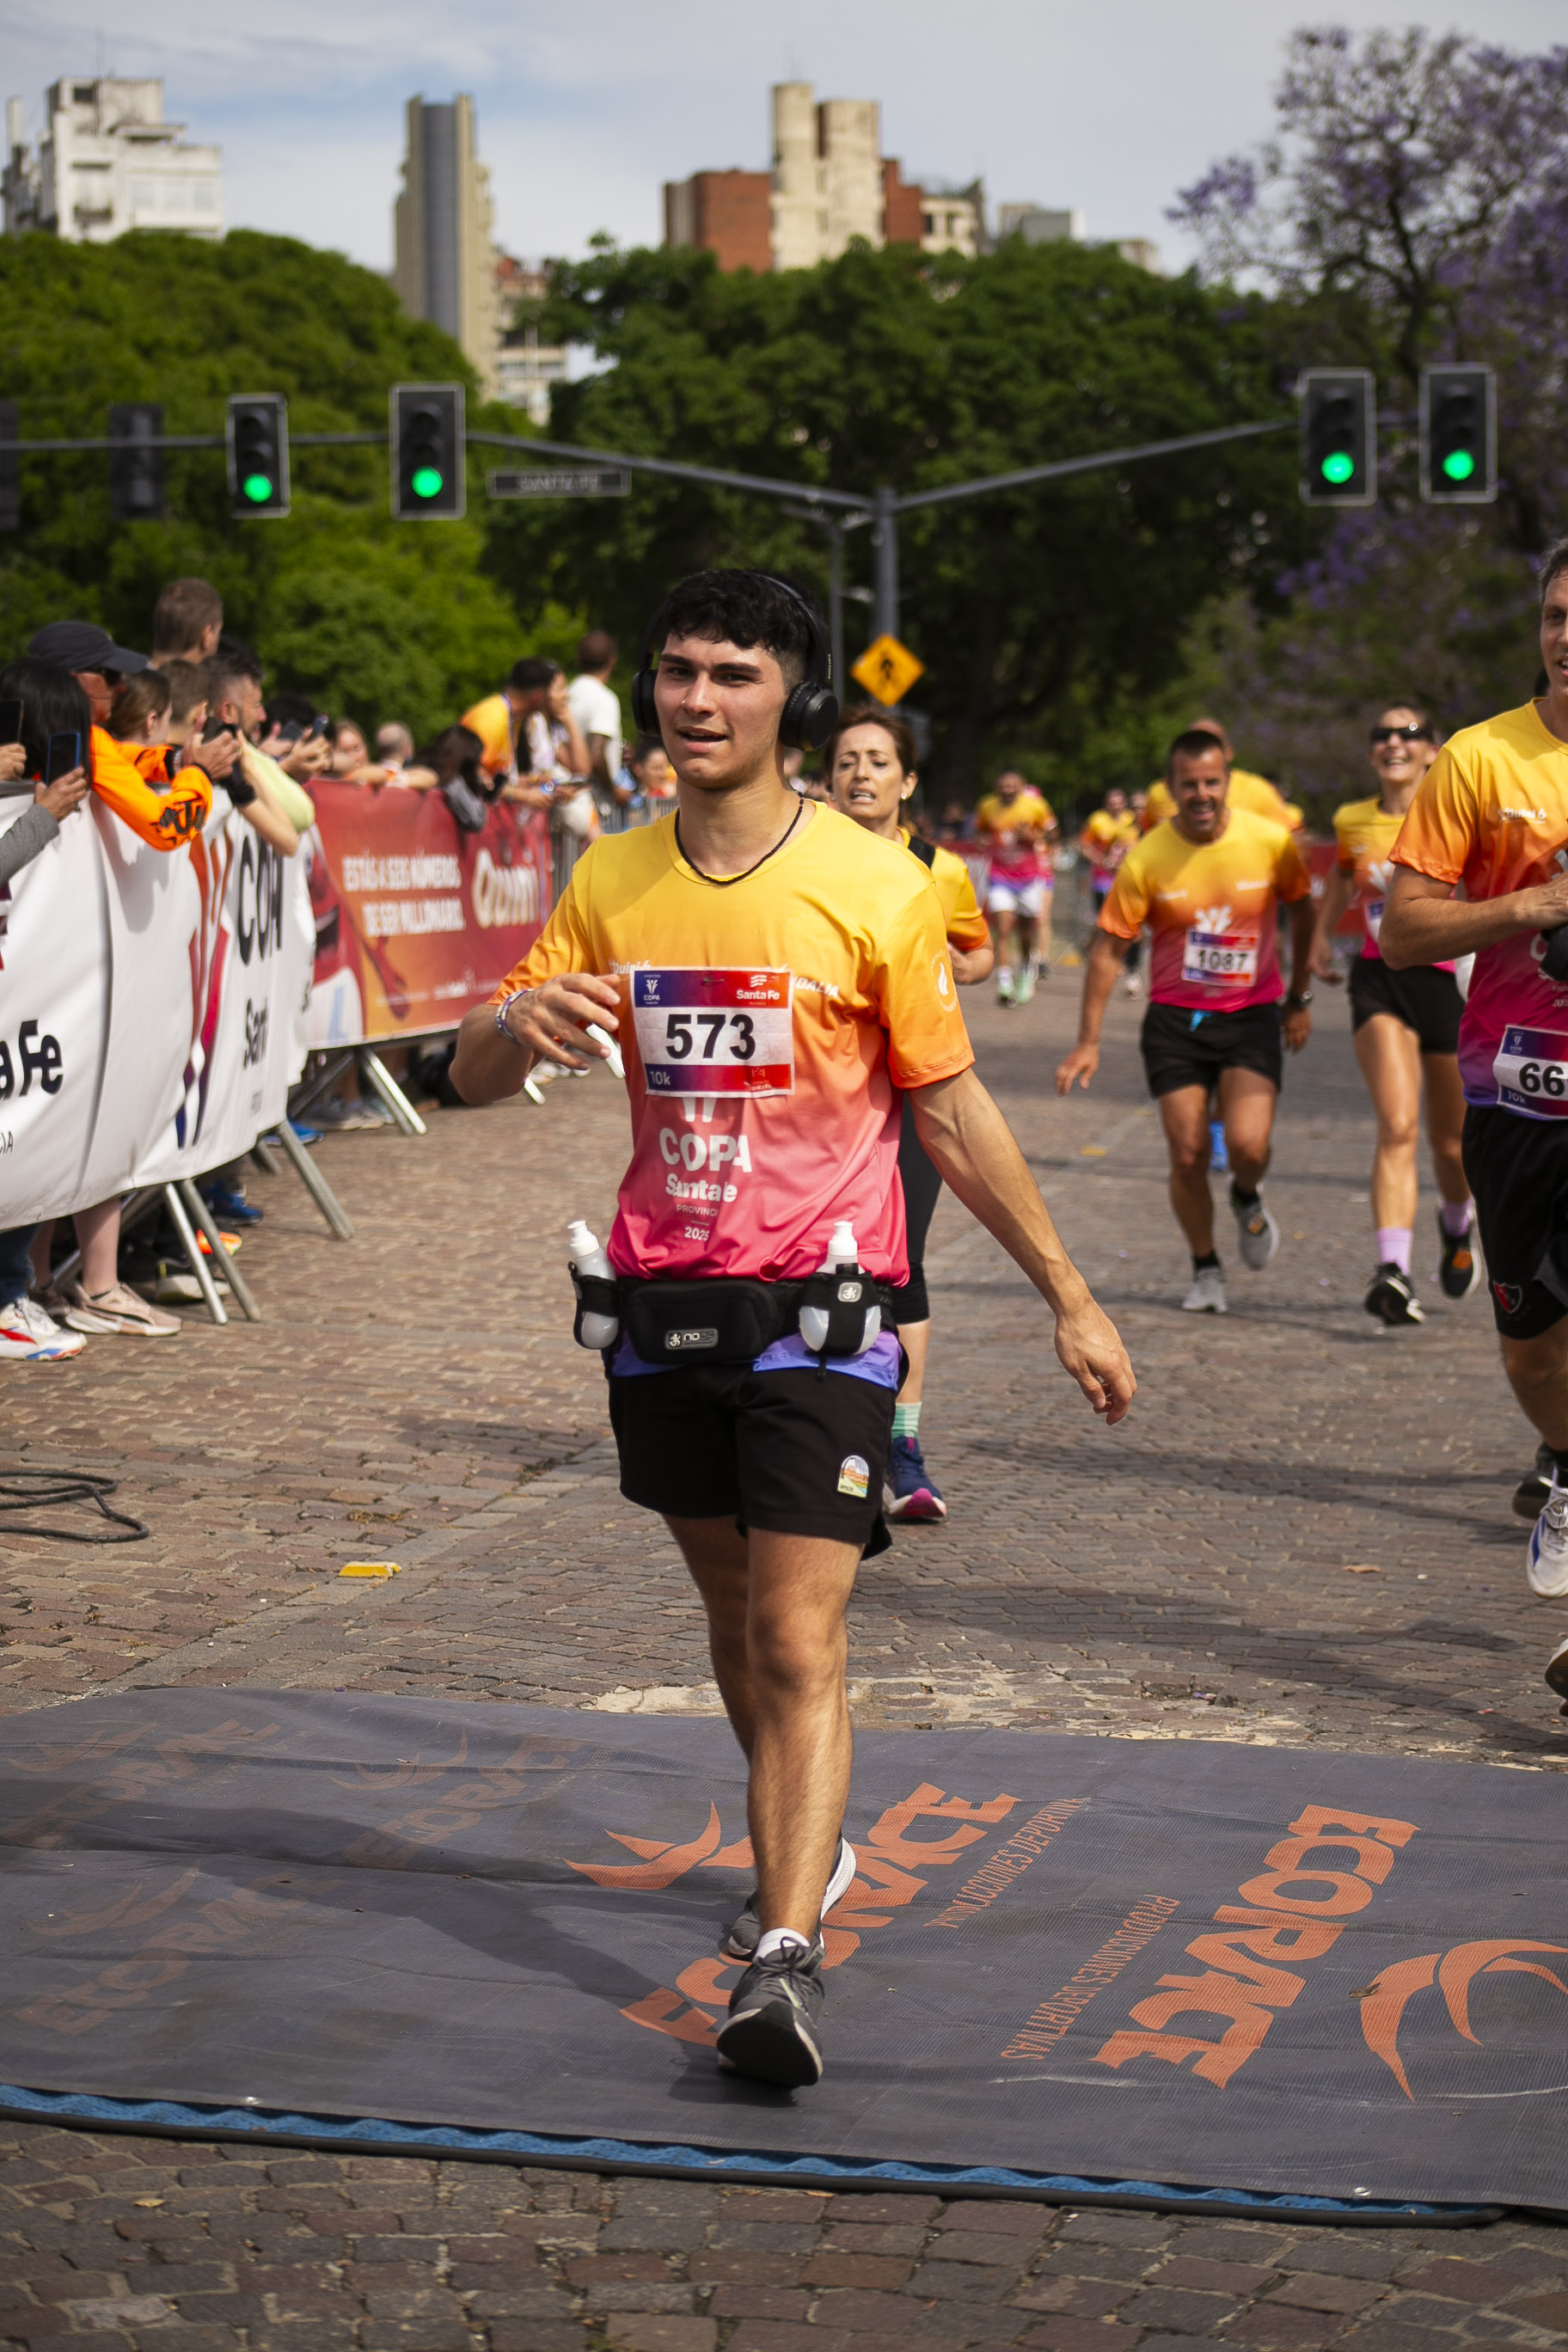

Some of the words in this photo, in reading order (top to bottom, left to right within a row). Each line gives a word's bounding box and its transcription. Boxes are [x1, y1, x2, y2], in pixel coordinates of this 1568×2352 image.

[1538, 808, 1547, 819] 6
[736, 989, 767, 1000] Santa
[767, 989, 780, 1000] Fe
[666, 1014, 756, 1060] 573
[651, 1071, 671, 1086] 10k
[1519, 1063, 1568, 1096] 66
[659, 1128, 753, 1173] COPA
[676, 1204, 719, 1217] PROVINCI
[1072, 1894, 1180, 1984] PRODUCCIONES
[1001, 1987, 1103, 2061] DEPORTIVAS
